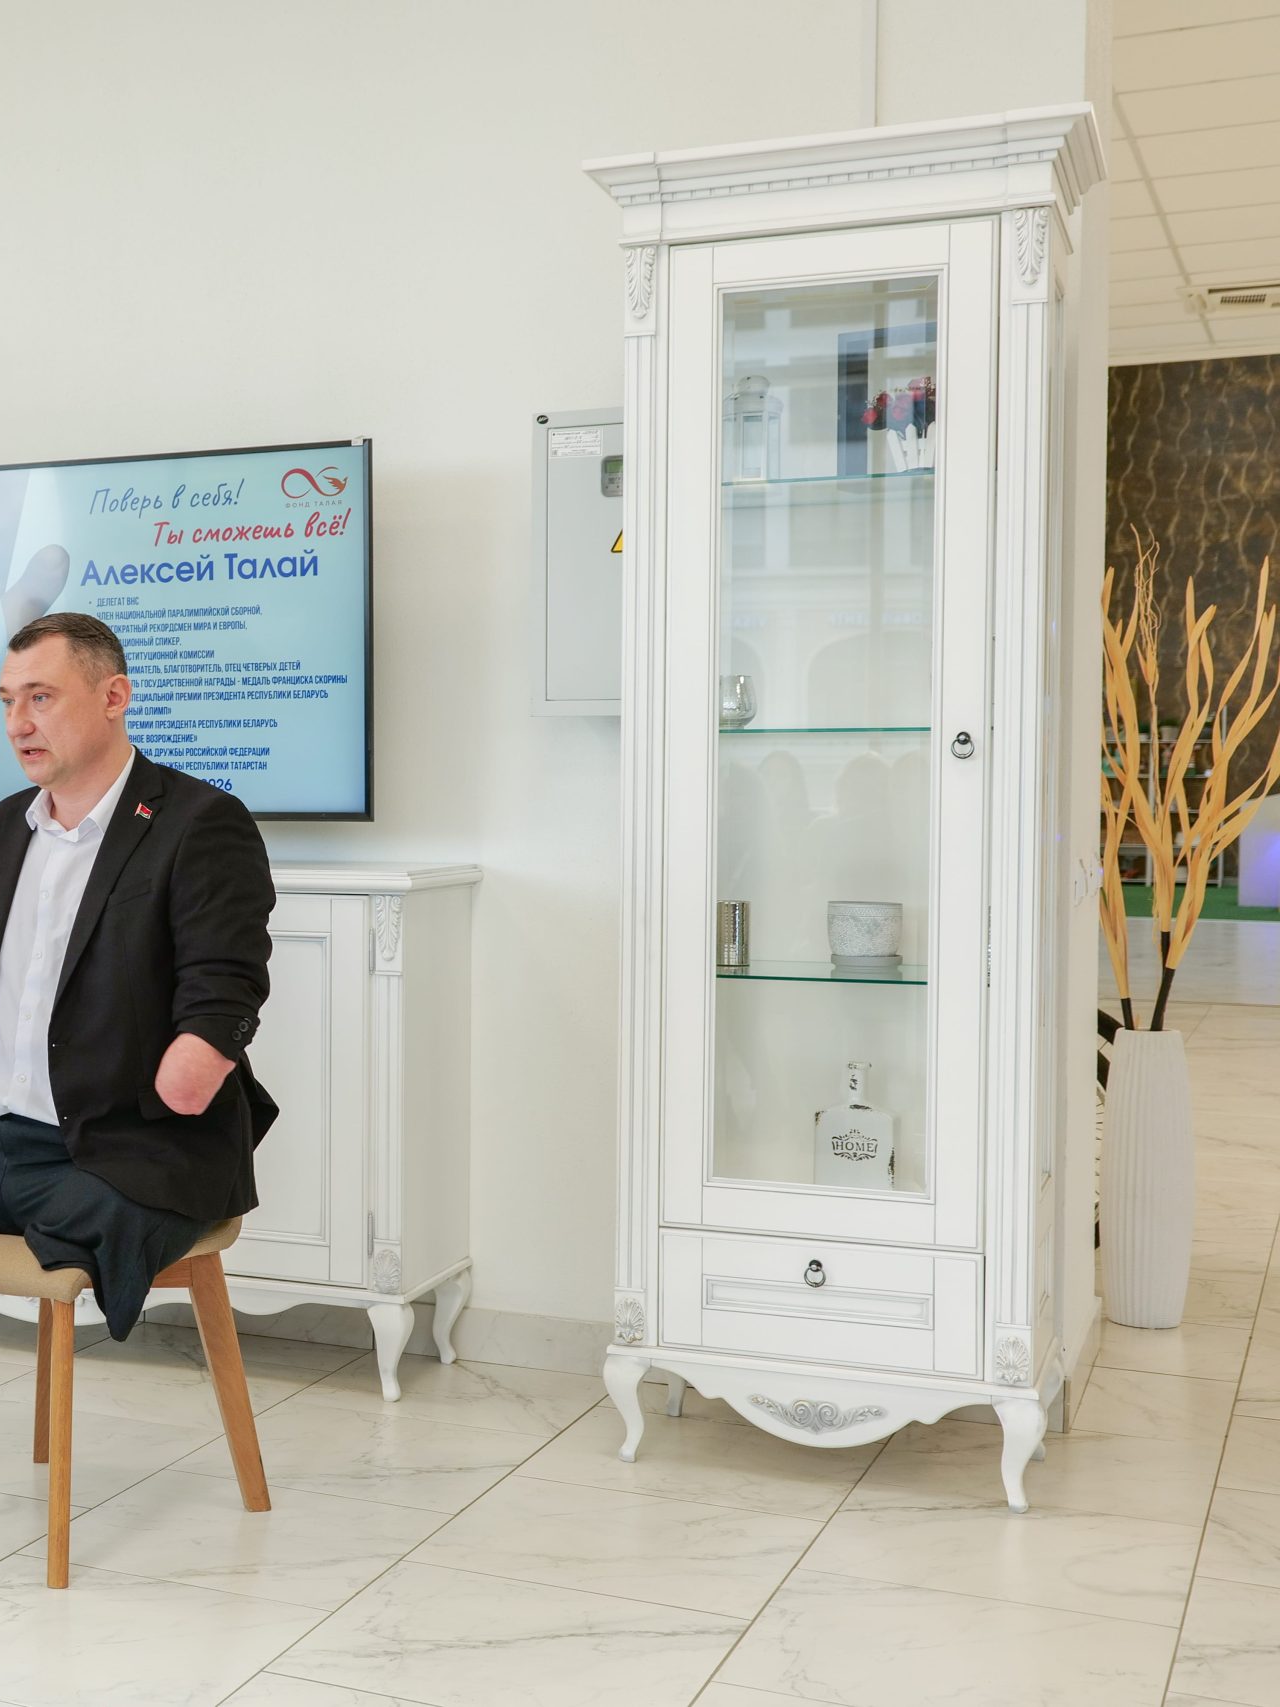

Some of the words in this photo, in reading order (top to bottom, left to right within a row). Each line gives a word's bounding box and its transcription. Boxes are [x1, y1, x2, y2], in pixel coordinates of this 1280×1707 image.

[89, 487, 163, 519] Поверь
[171, 484, 186, 509] в
[190, 478, 245, 507] себя!
[153, 521, 183, 547] Ты
[192, 520, 295, 544] сможешь
[304, 508, 352, 538] всё!
[80, 554, 214, 587] Алексей
[224, 549, 319, 580] Талай
[96, 597, 125, 607] ДЕЛЕГАТ
[126, 597, 140, 606] ВНС
[97, 611, 114, 620] ЧЛЕН
[115, 608, 166, 620] НАЦИОНАЛЬНОЙ
[167, 606, 230, 618] ПАРАЛИМПИЙСКОЙ
[109, 623, 148, 633] ГОКРАТНЫЙ
[149, 622, 192, 633] РЕКОРДСМЕН
[193, 621, 212, 631] МИРА
[213, 621, 218, 630] И
[121, 636, 154, 647] ЦИОННЫЙ
[124, 650, 178, 660] НСТИТУЦИОННОЙ
[179, 650, 215, 660] КОМИССИИ
[127, 664, 162, 674] НИМАТЕЛЬ,
[163, 663, 224, 674] БЛАГОТВОРИТЕЛЬ,
[224, 662, 241, 672] ОТЕЦ
[242, 661, 277, 672] ЧЕТВЕРЫХ
[278, 660, 301, 672] ДЕТЕЙ
[140, 677, 203, 688] ГОСУДАРСТВЕННОЙ
[204, 676, 235, 687] НАГРАДЫ
[241, 676, 271, 686] МЕДАЛЬ
[271, 675, 314, 685] ФРАНЦИСКА
[314, 674, 348, 685] СКОРИНЫ
[131, 691, 174, 702] ПЕЦИАЛЬНОЙ
[175, 692, 202, 701] ПРЕМИИ
[203, 691, 246, 701] ПРЕЗИДЕНТА
[247, 690, 292, 700] РЕСПУБЛИКИ
[292, 689, 328, 699] БЕЛАРУСЬ
[144, 706, 172, 716] ОЛИМП»
[127, 720, 154, 729] ПРЕМИИ
[154, 719, 197, 729] ПРЕЗИДЕНТА
[198, 719, 242, 729] РЕСПУБЛИКИ
[243, 718, 278, 728] БЕЛАРУСЬ
[128, 734, 145, 743] ВНОЕ
[145, 734, 198, 743] ВОЗРОЖДЕНИЕ»
[154, 747, 185, 757] ДРУЖБЫ
[185, 746, 228, 756] РОССИЙСКОЙ
[228, 747, 270, 757] ФЕДЕРАЦИИ
[185, 761, 229, 770] РЕСПУБЛИКИ
[230, 761, 268, 770] ТАТАРСТАН
[835, 1141, 874, 1152] HOME
